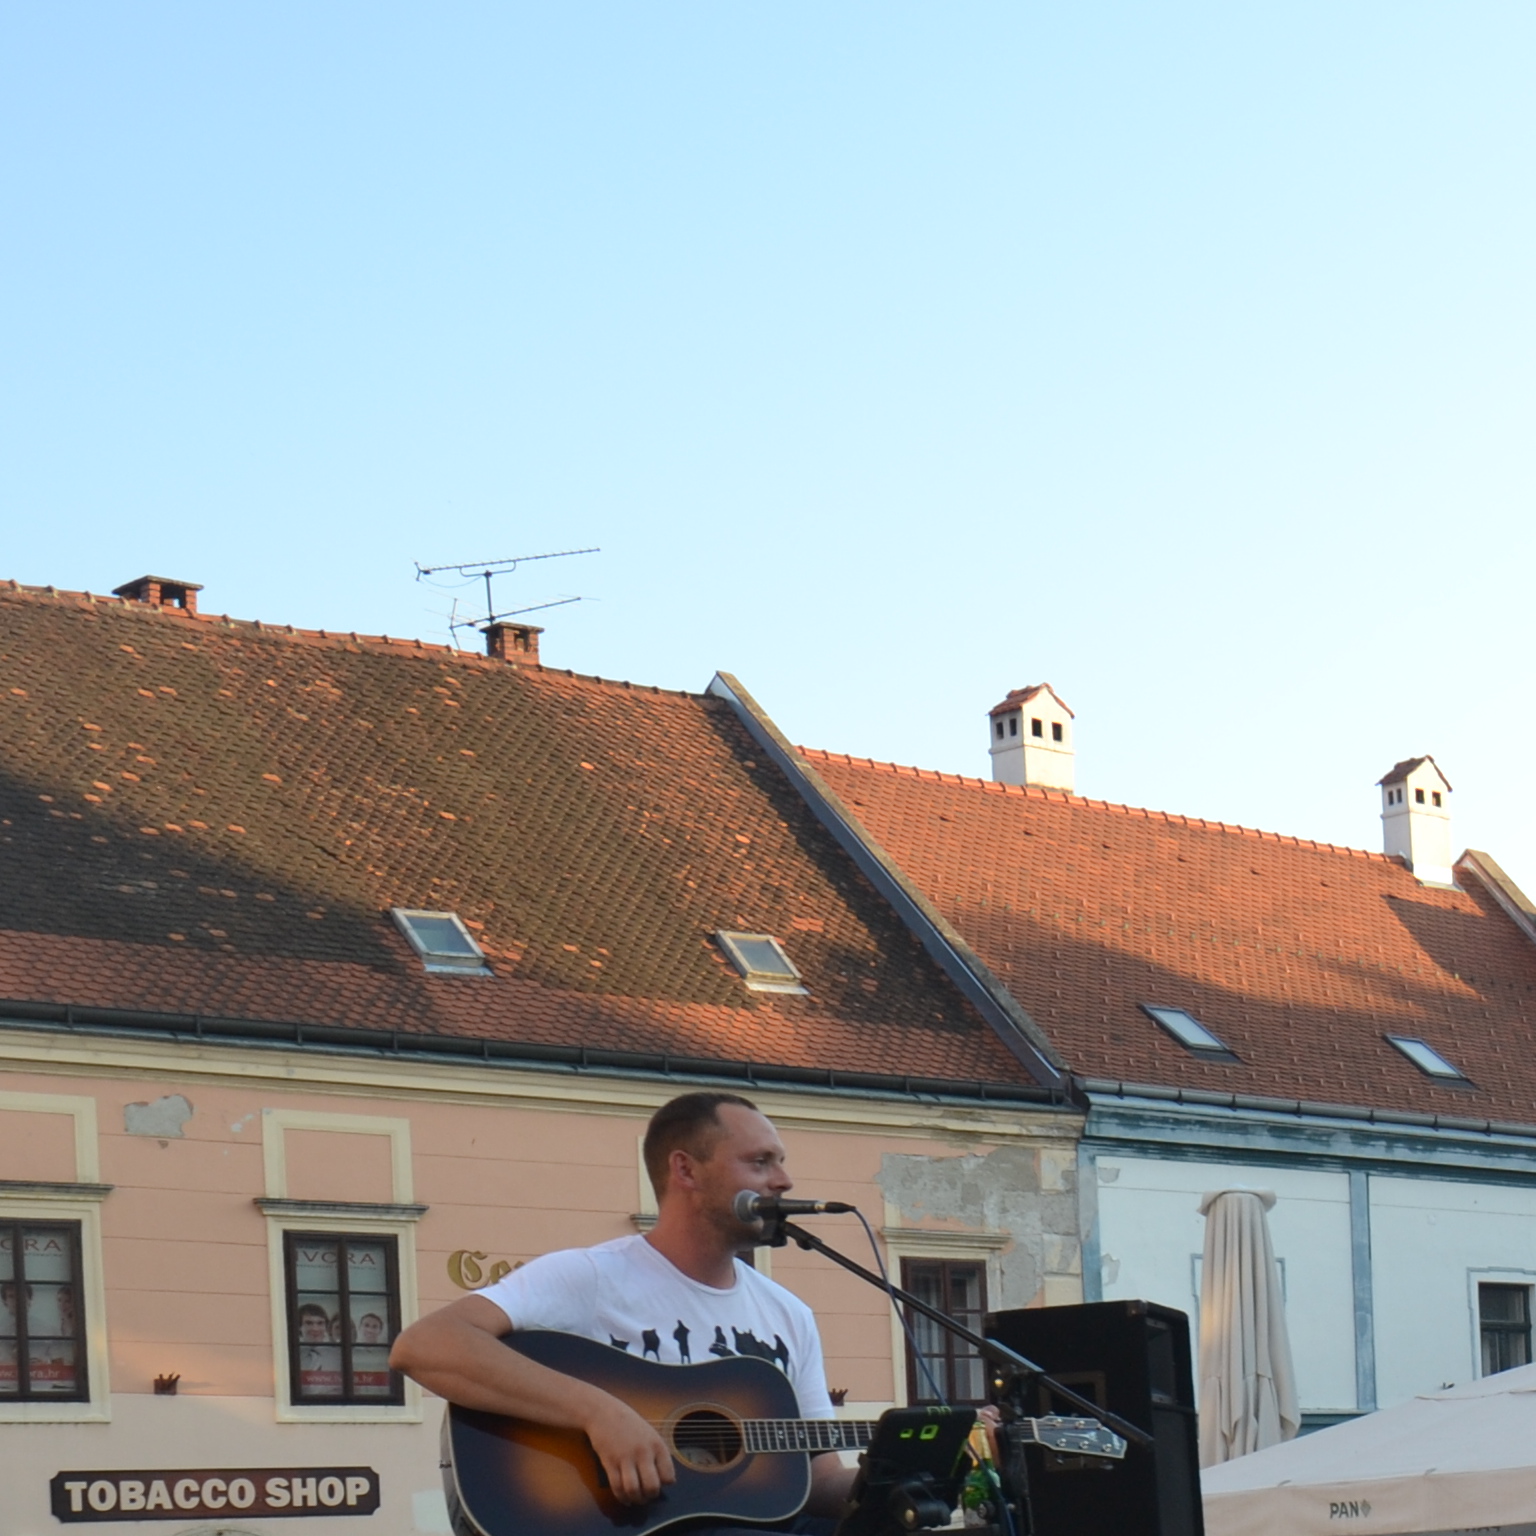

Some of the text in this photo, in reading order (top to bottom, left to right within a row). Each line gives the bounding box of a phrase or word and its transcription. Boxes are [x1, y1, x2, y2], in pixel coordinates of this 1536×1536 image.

[64, 1476, 370, 1512] TOBACCO SHOP
[1329, 1501, 1359, 1519] PAN
